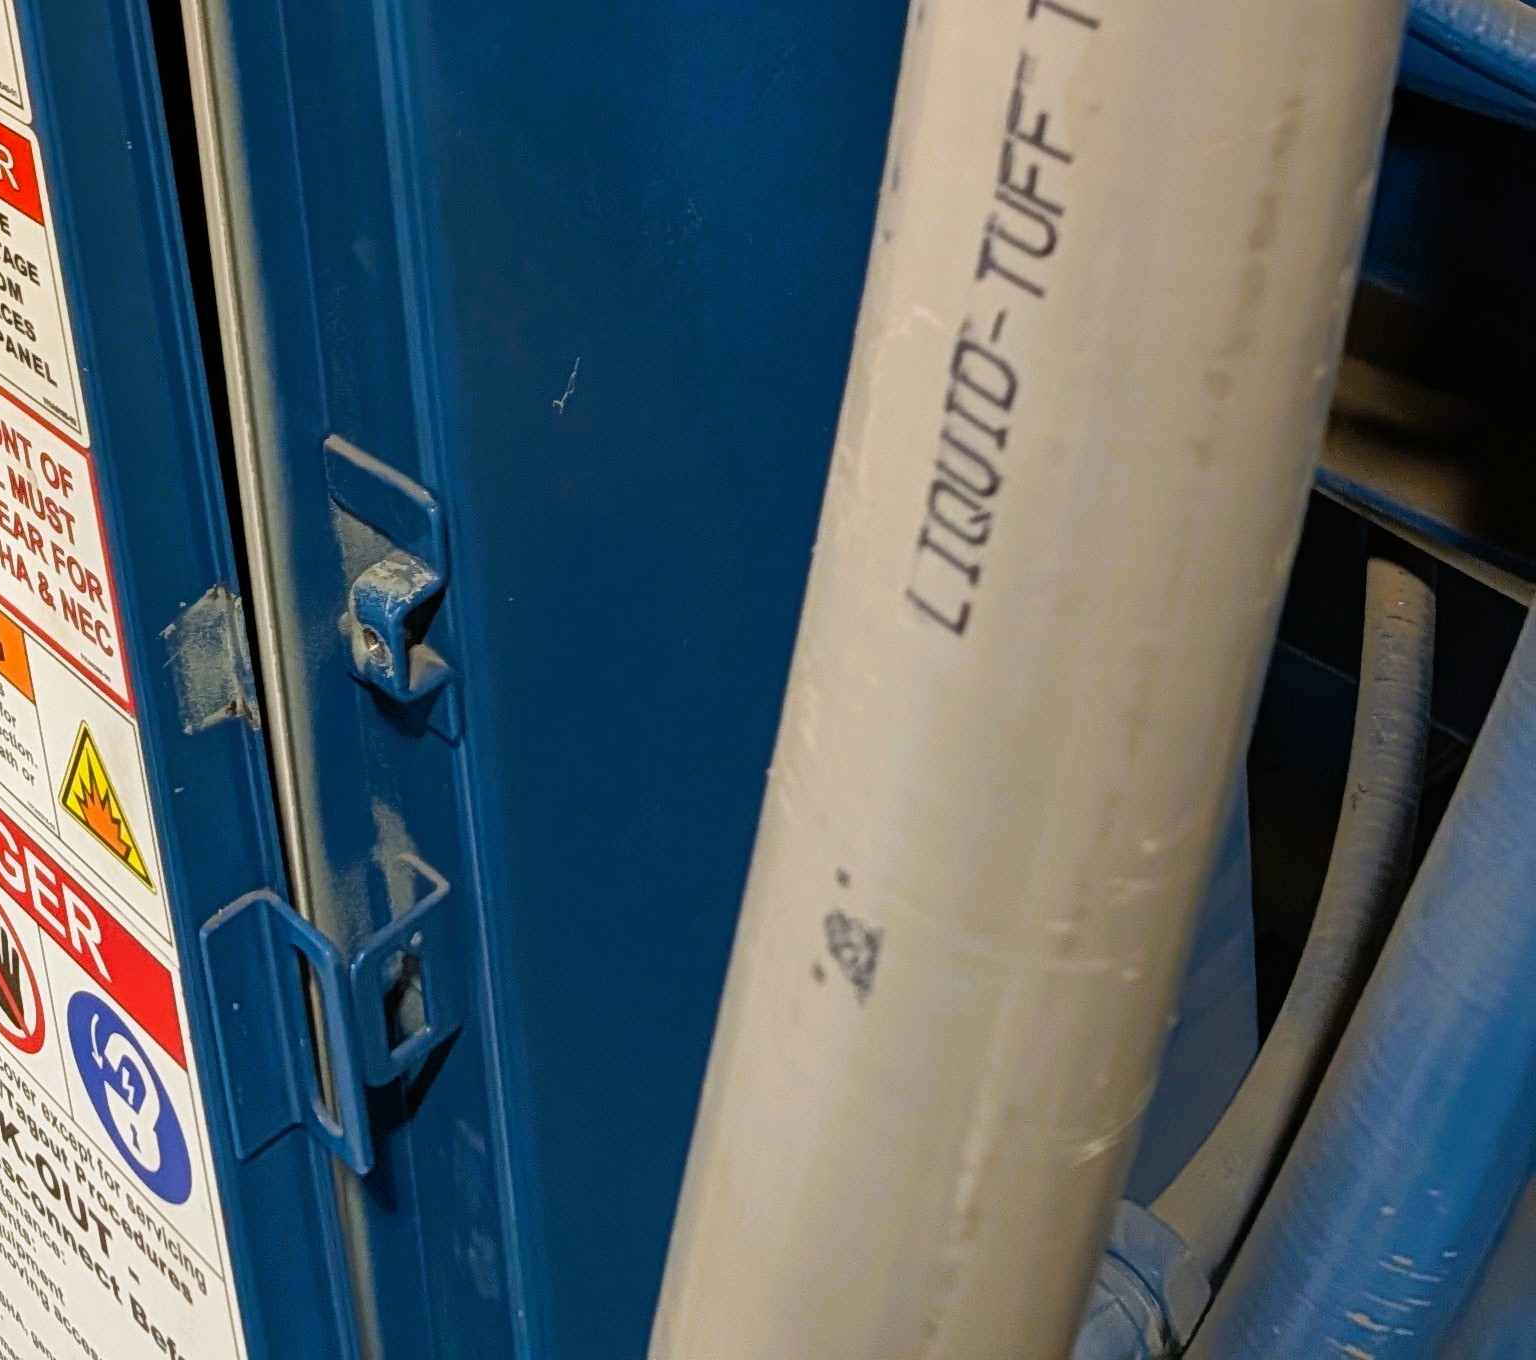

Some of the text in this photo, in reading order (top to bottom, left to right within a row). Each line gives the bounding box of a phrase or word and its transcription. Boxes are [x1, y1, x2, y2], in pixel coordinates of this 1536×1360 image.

[903, 49, 1075, 637] LIQUID-TUFF
[7, 466, 74, 544] MUST
[39, 451, 73, 497] OF
[37, 571, 56, 611] &
[59, 588, 113, 656] NEC
[50, 541, 107, 612] FOR
[21, 766, 34, 785] or
[40, 1102, 94, 1170] except
[96, 1157, 120, 1197] for
[125, 1193, 207, 1295] servicing
[74, 1161, 192, 1304] Procedures
